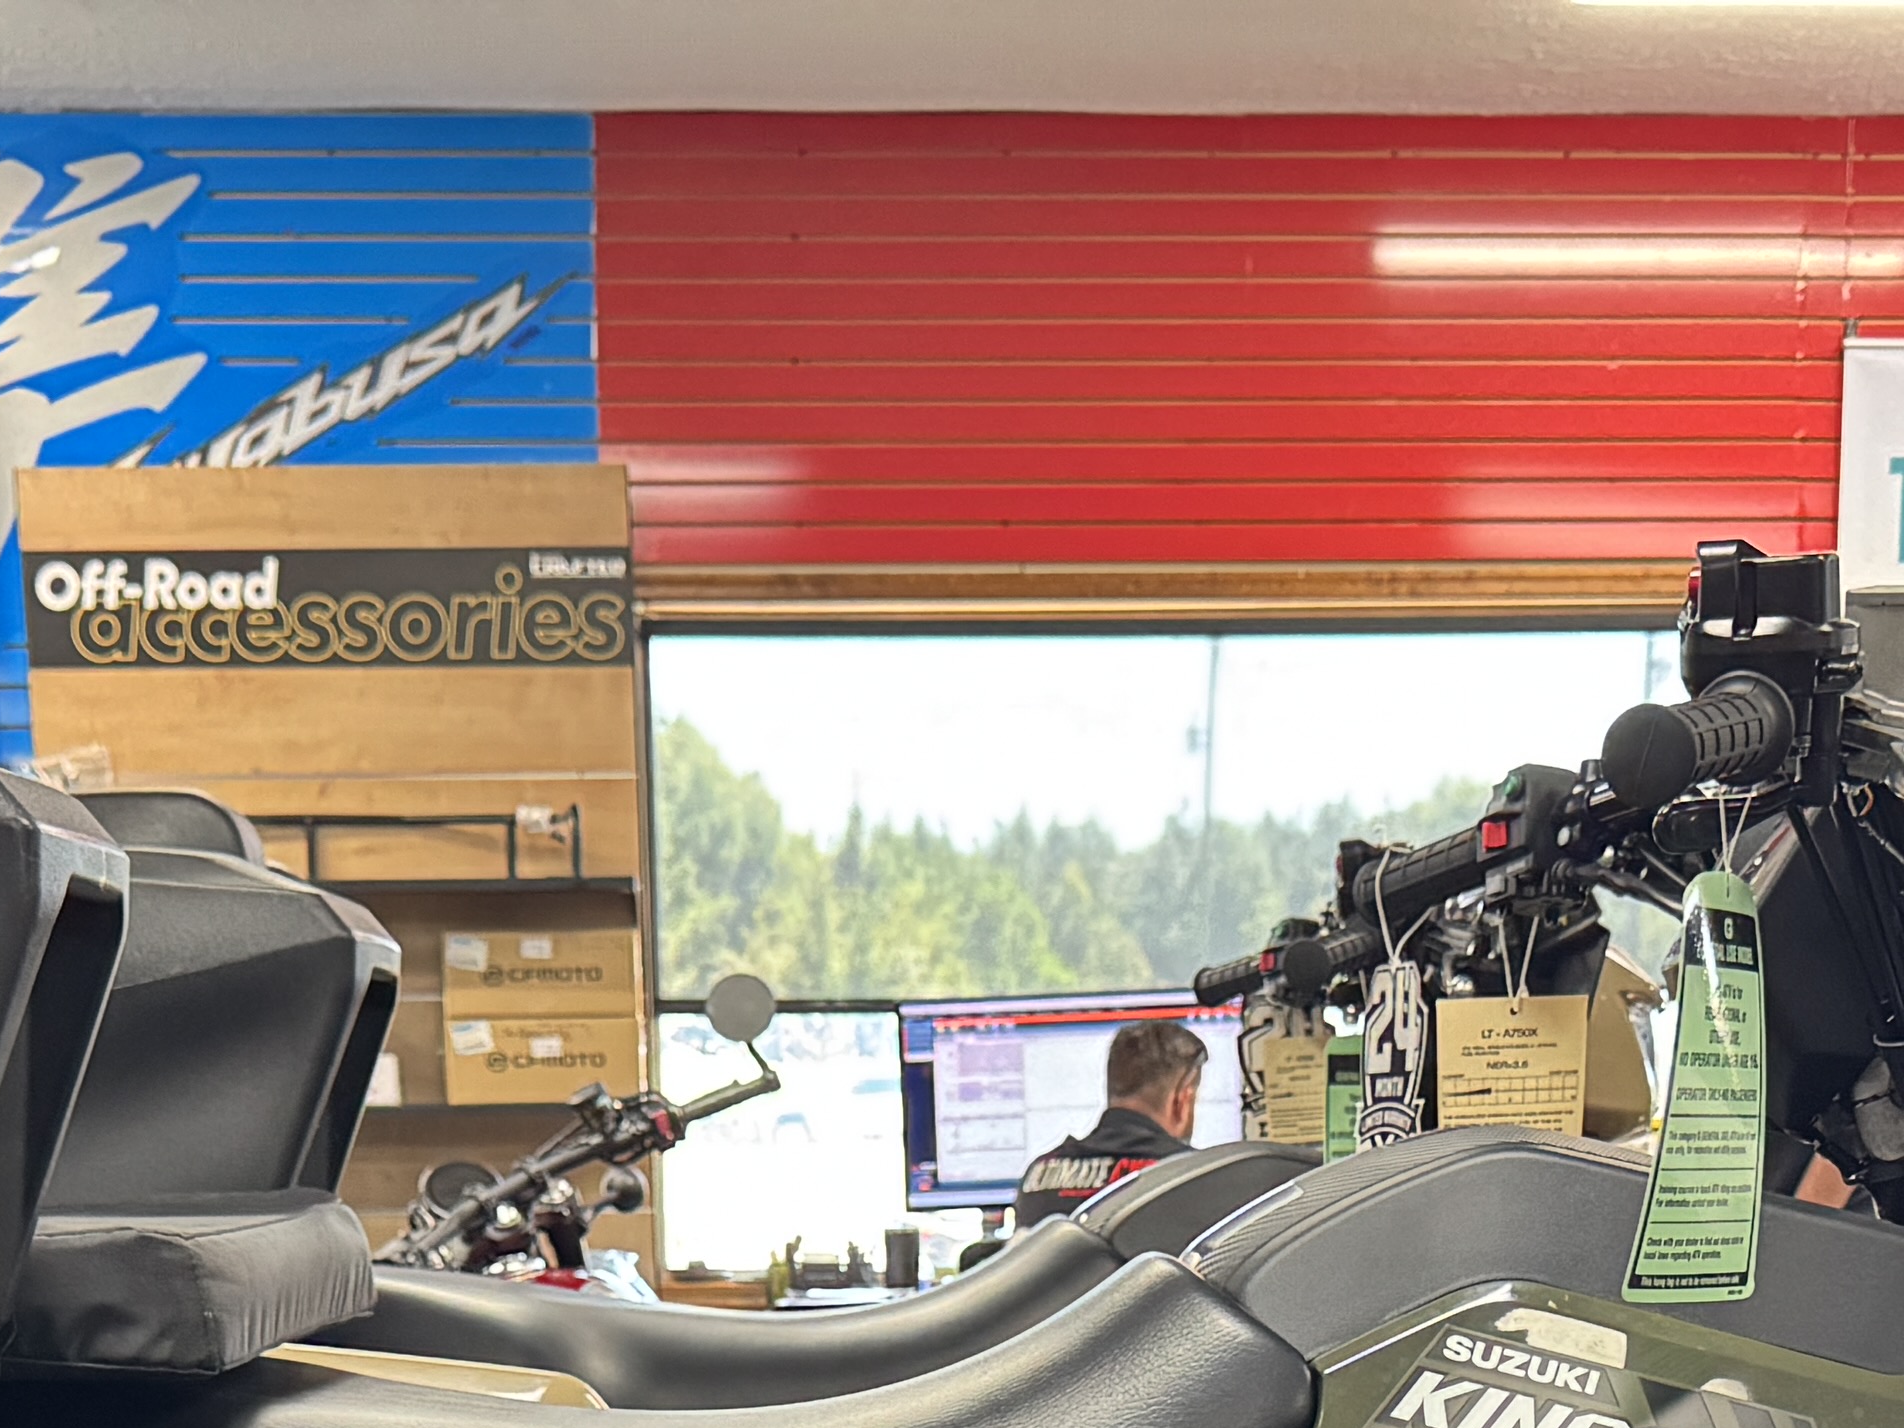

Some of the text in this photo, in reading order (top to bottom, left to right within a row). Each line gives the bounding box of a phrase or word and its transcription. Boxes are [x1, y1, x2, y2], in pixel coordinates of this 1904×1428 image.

[181, 272, 578, 468] abusa
[34, 557, 279, 612] Off-Road
[69, 566, 626, 663] accessories
[1442, 1333, 1600, 1396] SUZUKI
